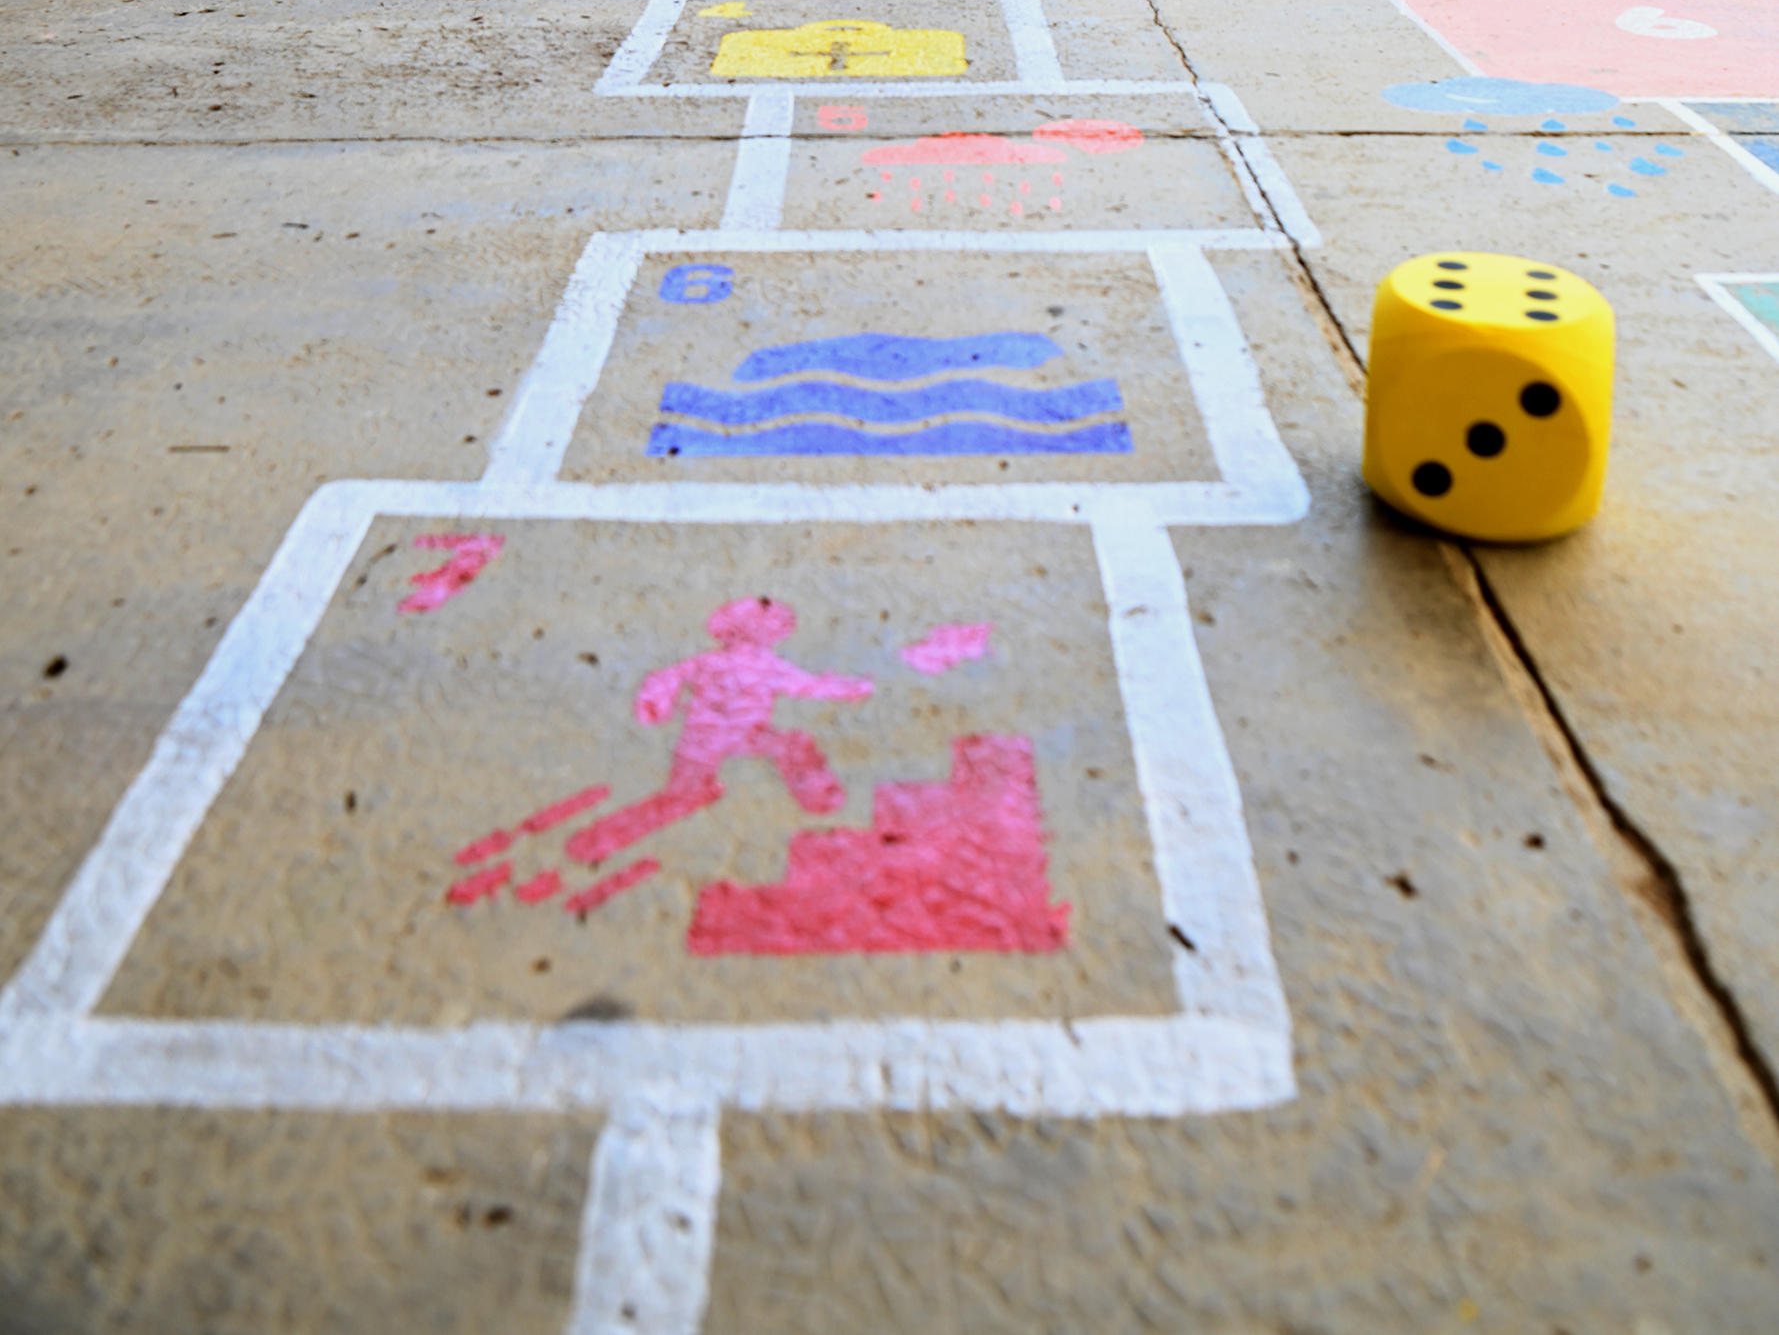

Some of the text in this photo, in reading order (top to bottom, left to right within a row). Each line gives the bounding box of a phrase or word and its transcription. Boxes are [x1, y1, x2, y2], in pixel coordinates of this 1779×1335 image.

[698, 1, 753, 18] 4
[1615, 5, 1719, 39] 6
[818, 105, 868, 131] 5
[659, 264, 735, 304] 6
[397, 534, 506, 614] 7
